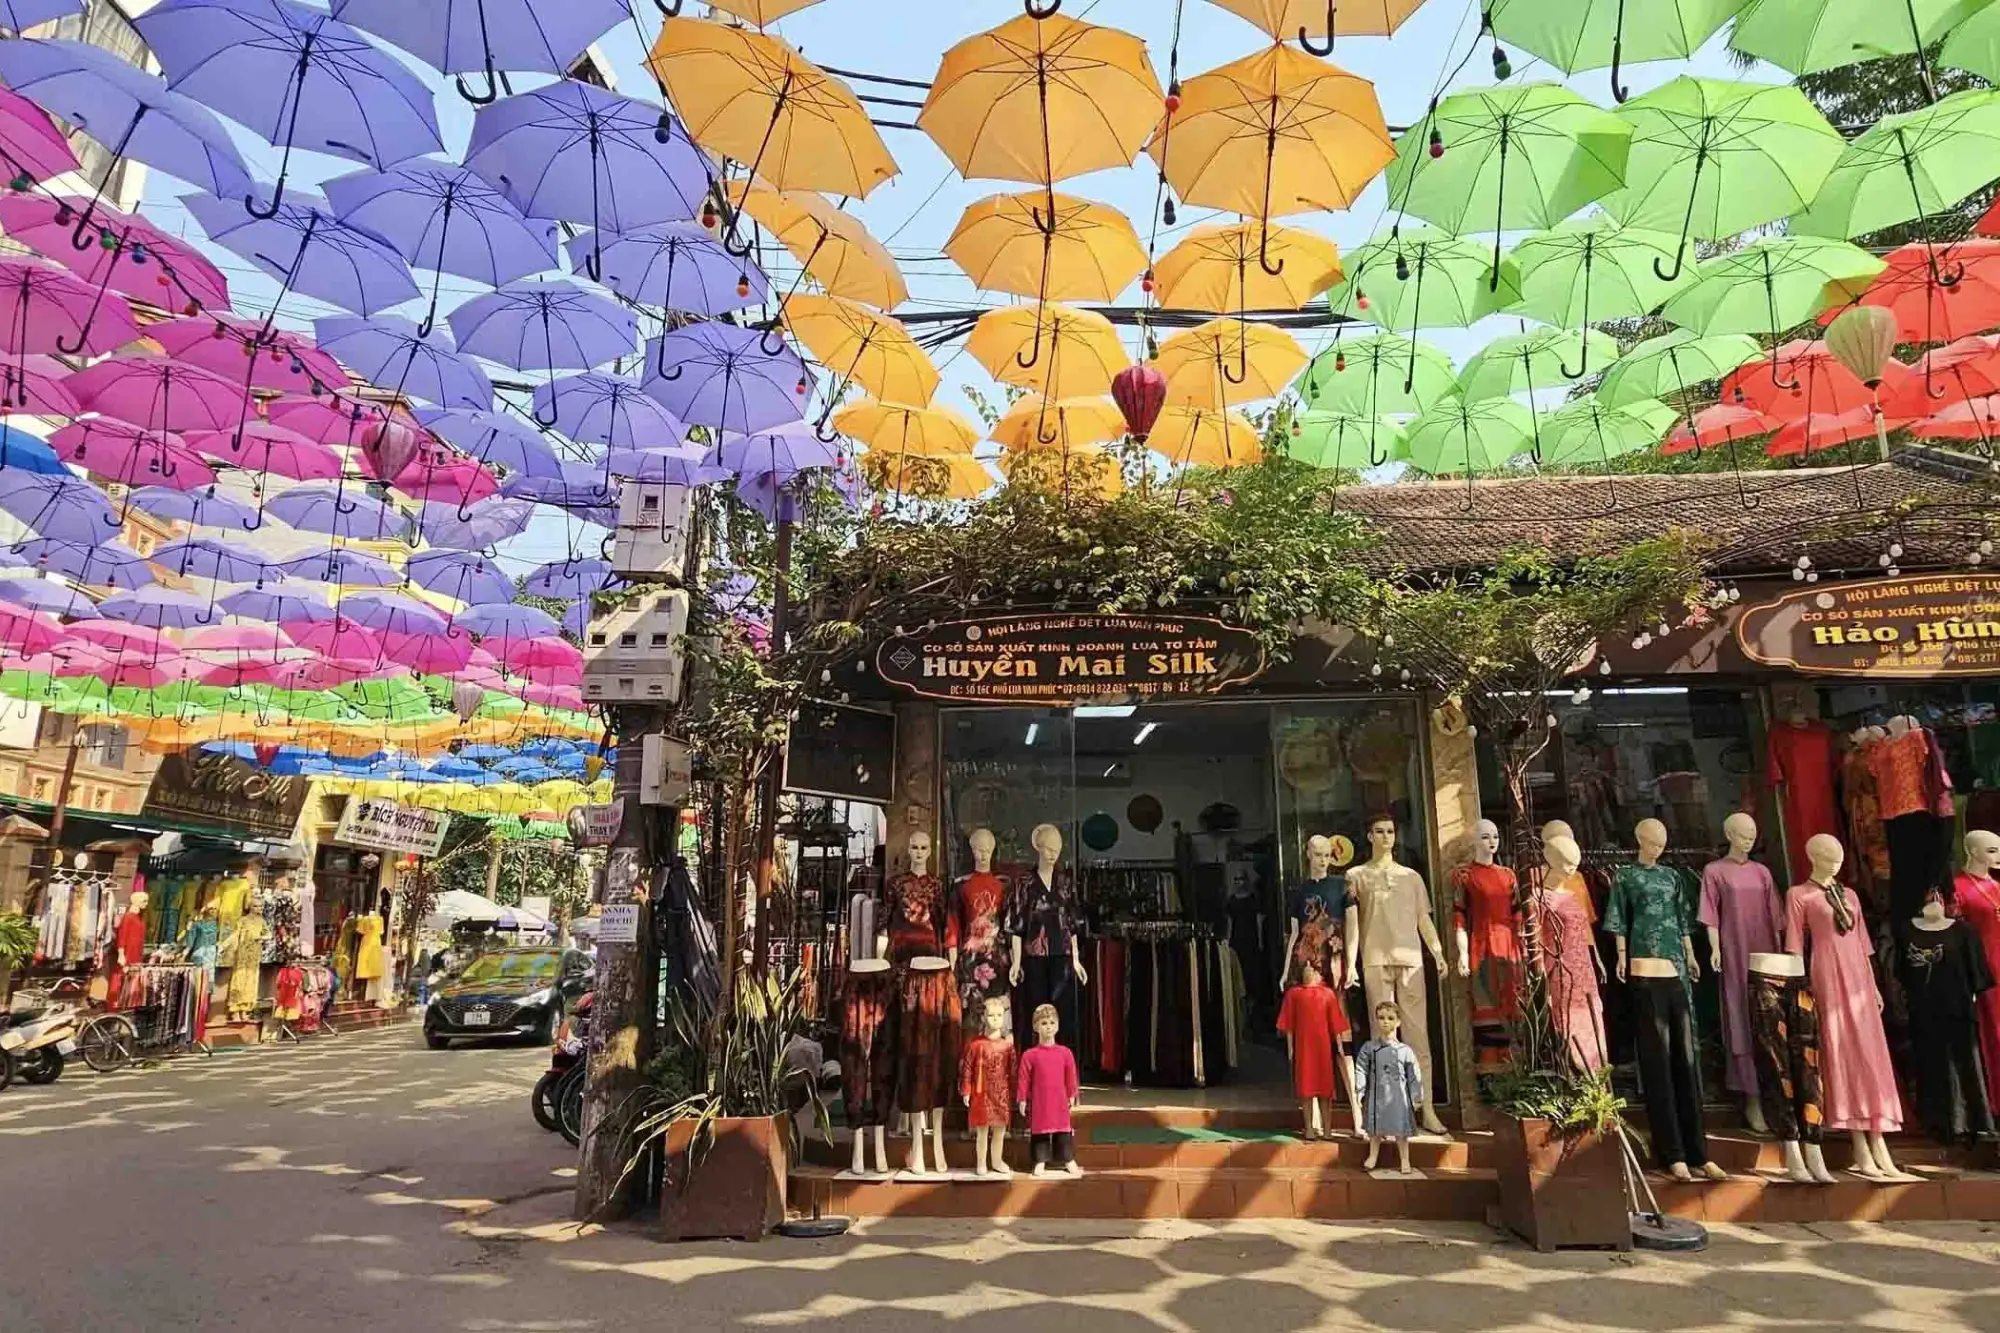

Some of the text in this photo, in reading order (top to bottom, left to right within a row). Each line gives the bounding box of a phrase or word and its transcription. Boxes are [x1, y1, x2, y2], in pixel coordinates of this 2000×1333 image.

[1985, 580, 2000, 593] LỤ
[1929, 604, 1967, 616] KINH
[1812, 621, 1899, 644] Hảo
[1039, 643, 1071, 652] KINH
[1076, 642, 1125, 652] DOANH
[923, 650, 1037, 681] Huyền
[1058, 654, 1126, 676] Mai
[1147, 652, 1218, 674] Silk
